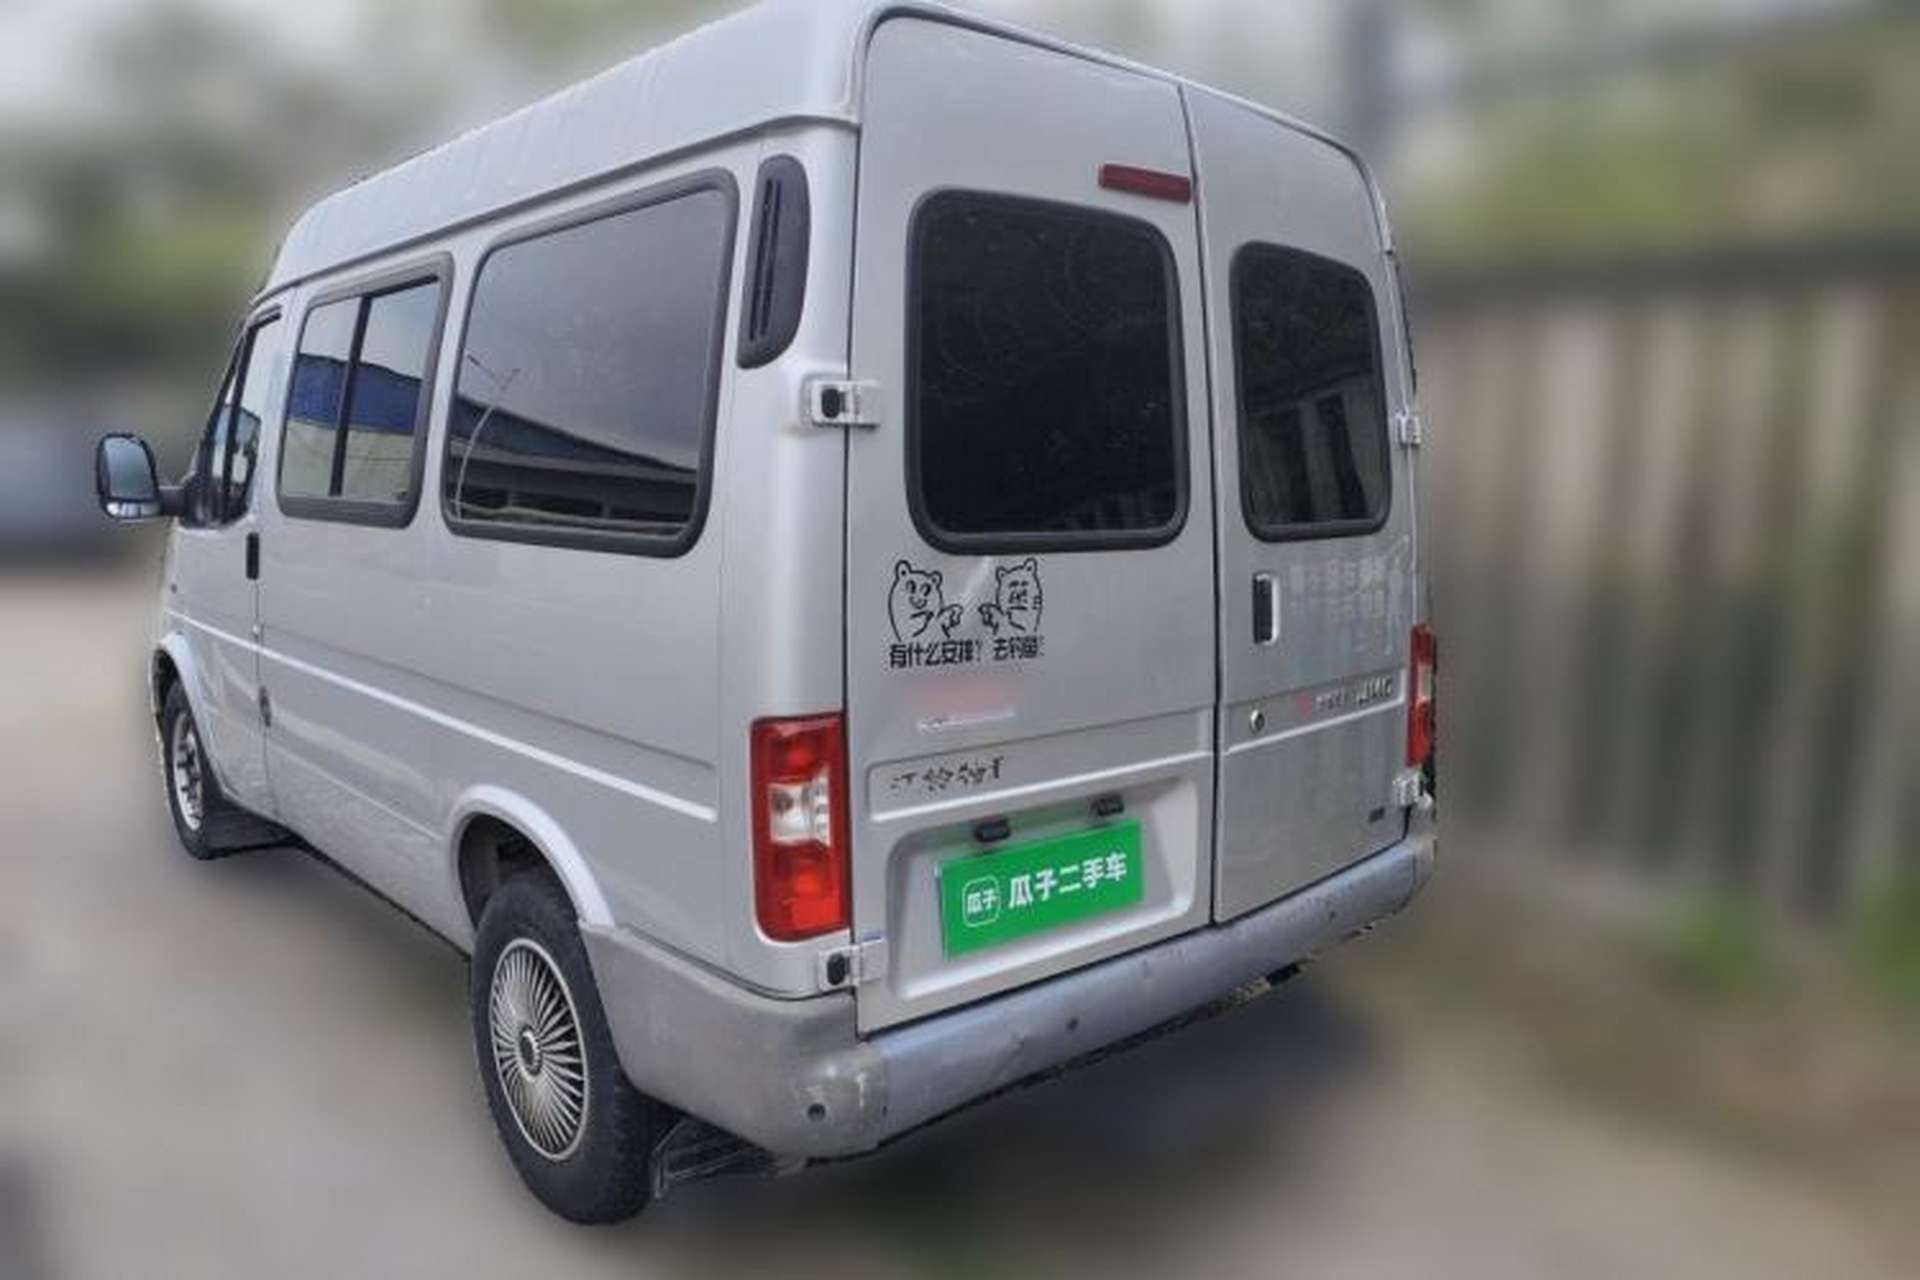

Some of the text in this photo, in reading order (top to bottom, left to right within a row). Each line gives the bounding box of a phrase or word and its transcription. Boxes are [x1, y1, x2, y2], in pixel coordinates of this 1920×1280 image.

[967, 851, 1128, 914] 瓜子 瓜子二手车
